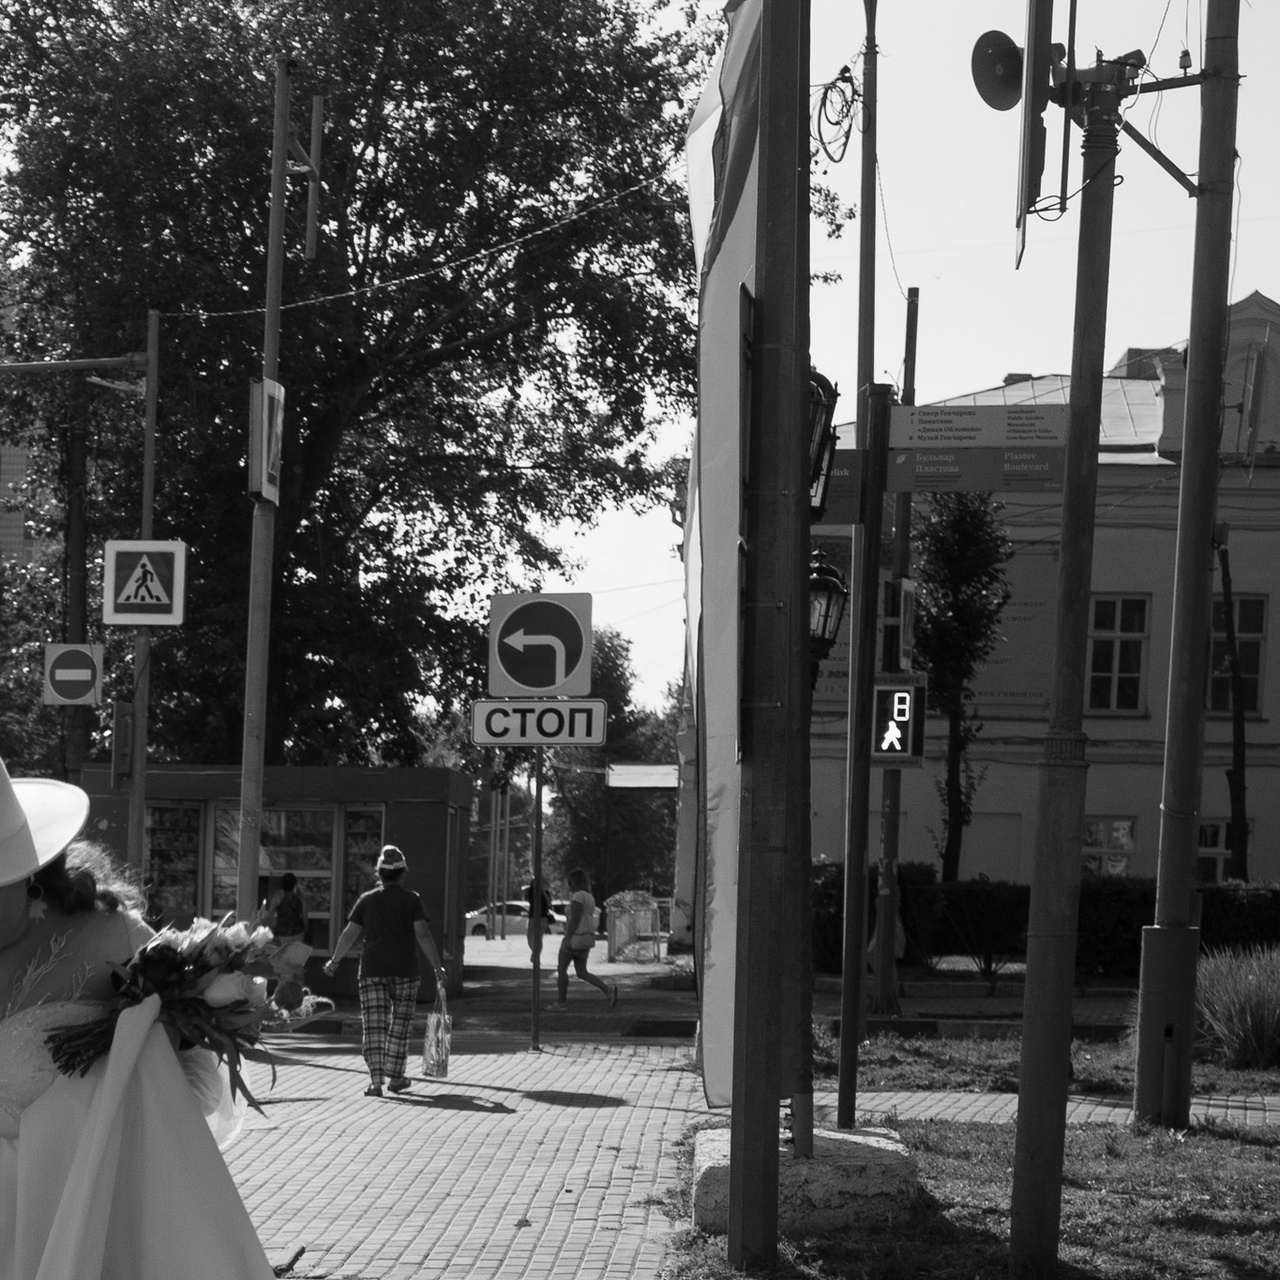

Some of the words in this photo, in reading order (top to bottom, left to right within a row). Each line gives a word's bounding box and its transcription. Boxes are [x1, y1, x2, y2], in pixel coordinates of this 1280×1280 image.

[917, 434, 939, 442] Музей
[916, 453, 955, 463] Бульвар
[1004, 452, 1037, 460] Plastov
[915, 464, 960, 472] Пластова
[1004, 462, 1049, 471] Boulevard
[829, 468, 850, 477] elisk
[893, 692, 910, 721] 8
[484, 707, 593, 738] СТОП
